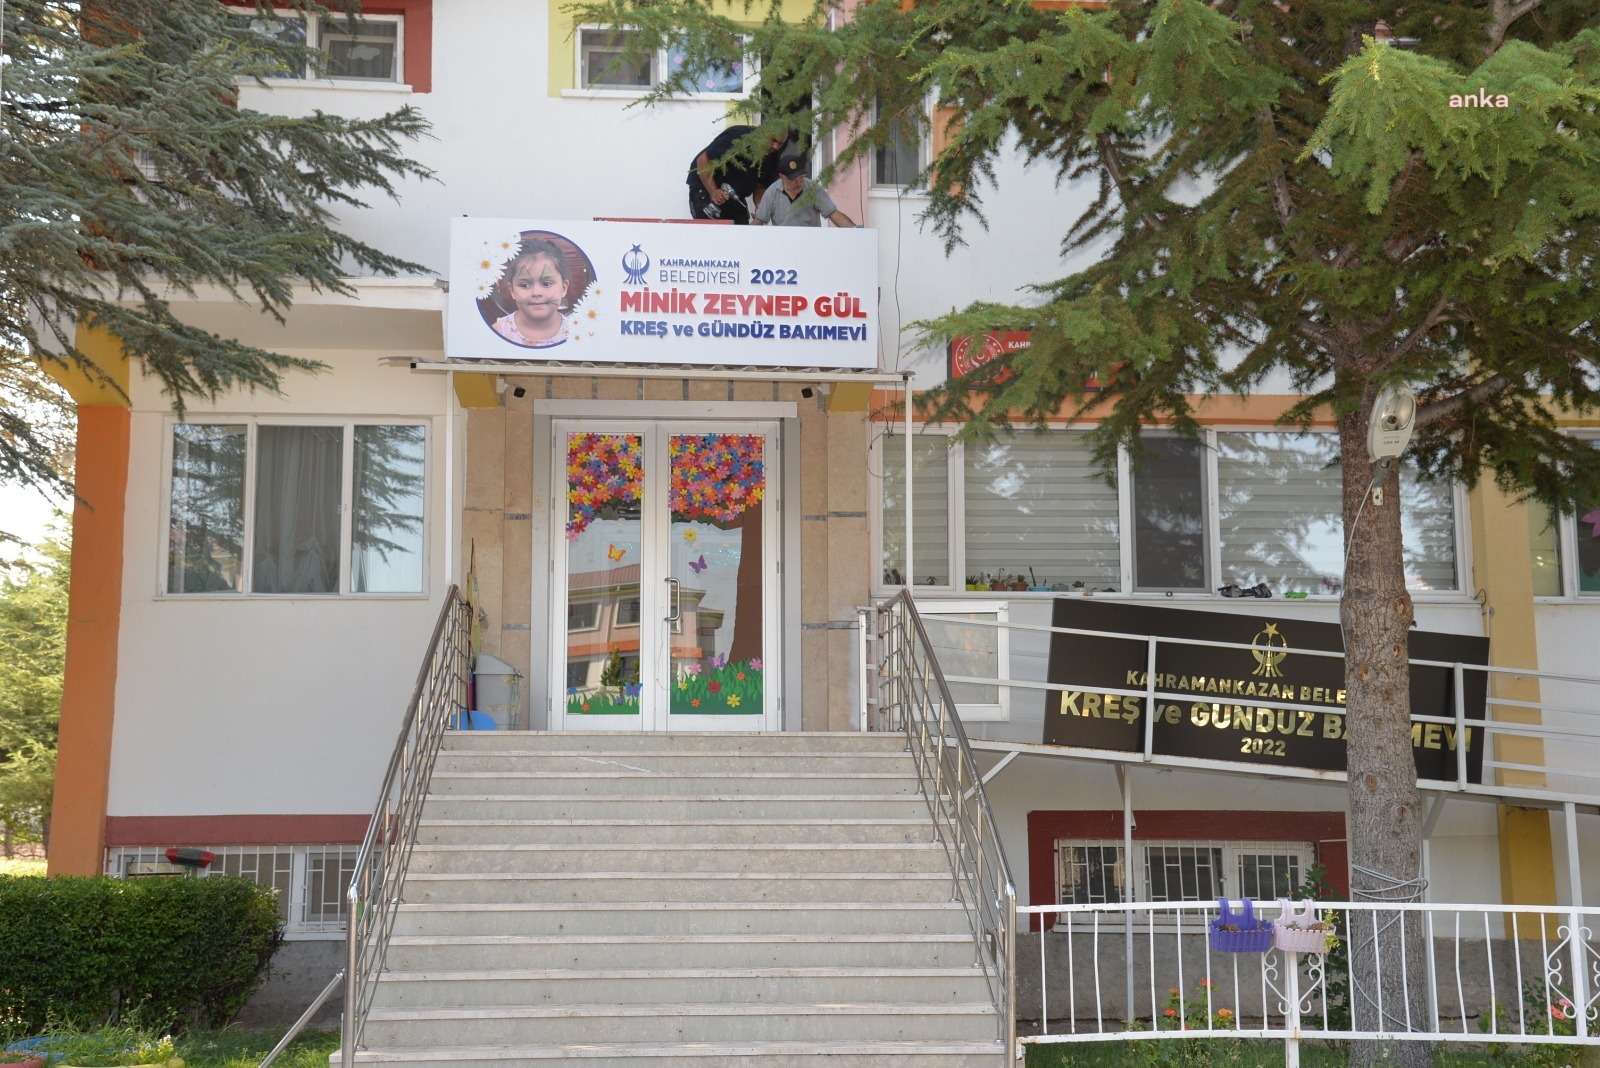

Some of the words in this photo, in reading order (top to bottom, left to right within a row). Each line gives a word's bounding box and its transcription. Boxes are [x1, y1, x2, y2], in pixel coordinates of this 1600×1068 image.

[660, 258, 740, 269] KAHRAMANKAZAN
[660, 269, 740, 284] BELEDİYESİ
[750, 268, 798, 285] 2022
[620, 286, 697, 315] MİNİK
[703, 293, 808, 317] ZEYNEP
[813, 291, 867, 318] GÜL
[620, 319, 668, 339] KREŞ
[672, 324, 694, 337] ve
[697, 319, 775, 339] GÜNDÜZ
[779, 323, 867, 341] BAKIMEVİ
[1126, 669, 1295, 700] KAHRAMANKAZAN
[1060, 690, 1140, 725] KREŞ
[1240, 736, 1287, 757] 2022
